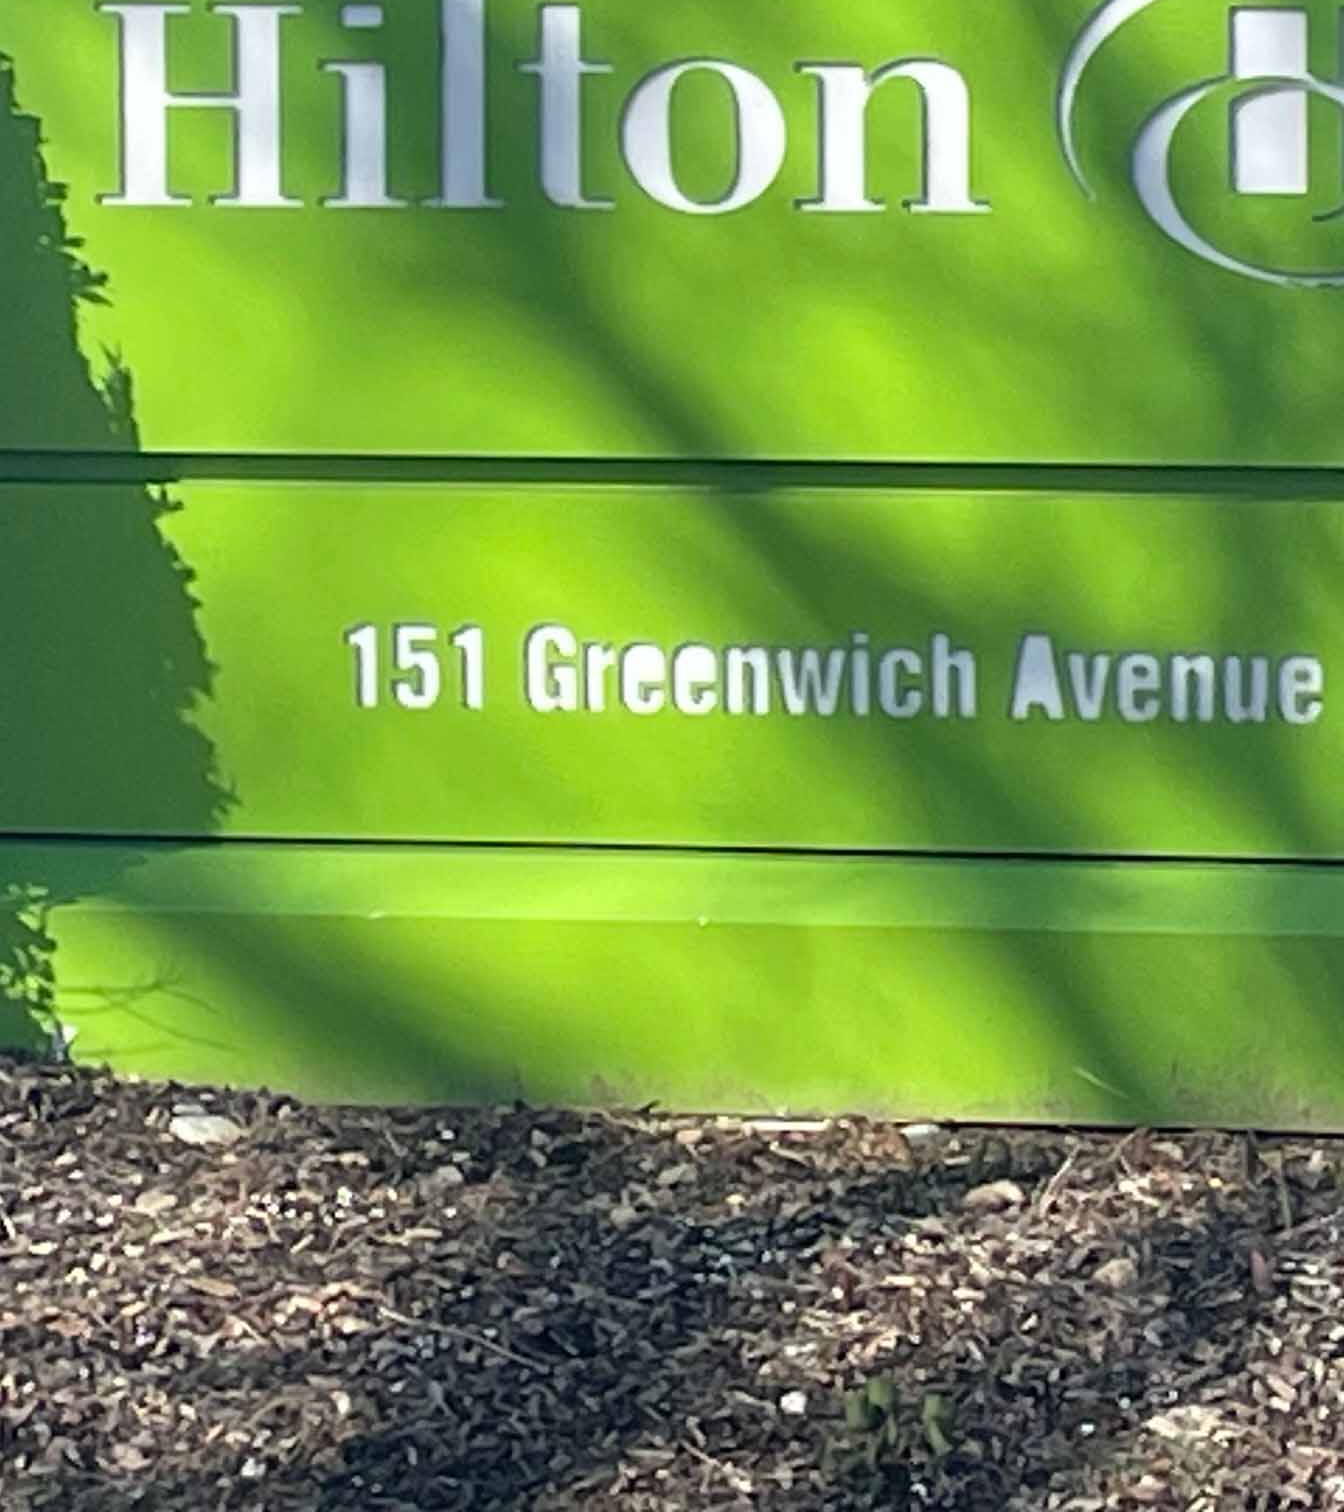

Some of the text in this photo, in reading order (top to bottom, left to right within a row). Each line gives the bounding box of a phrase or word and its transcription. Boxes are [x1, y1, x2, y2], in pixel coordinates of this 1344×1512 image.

[345, 622, 1325, 726] 151 Greenwich Avenue
